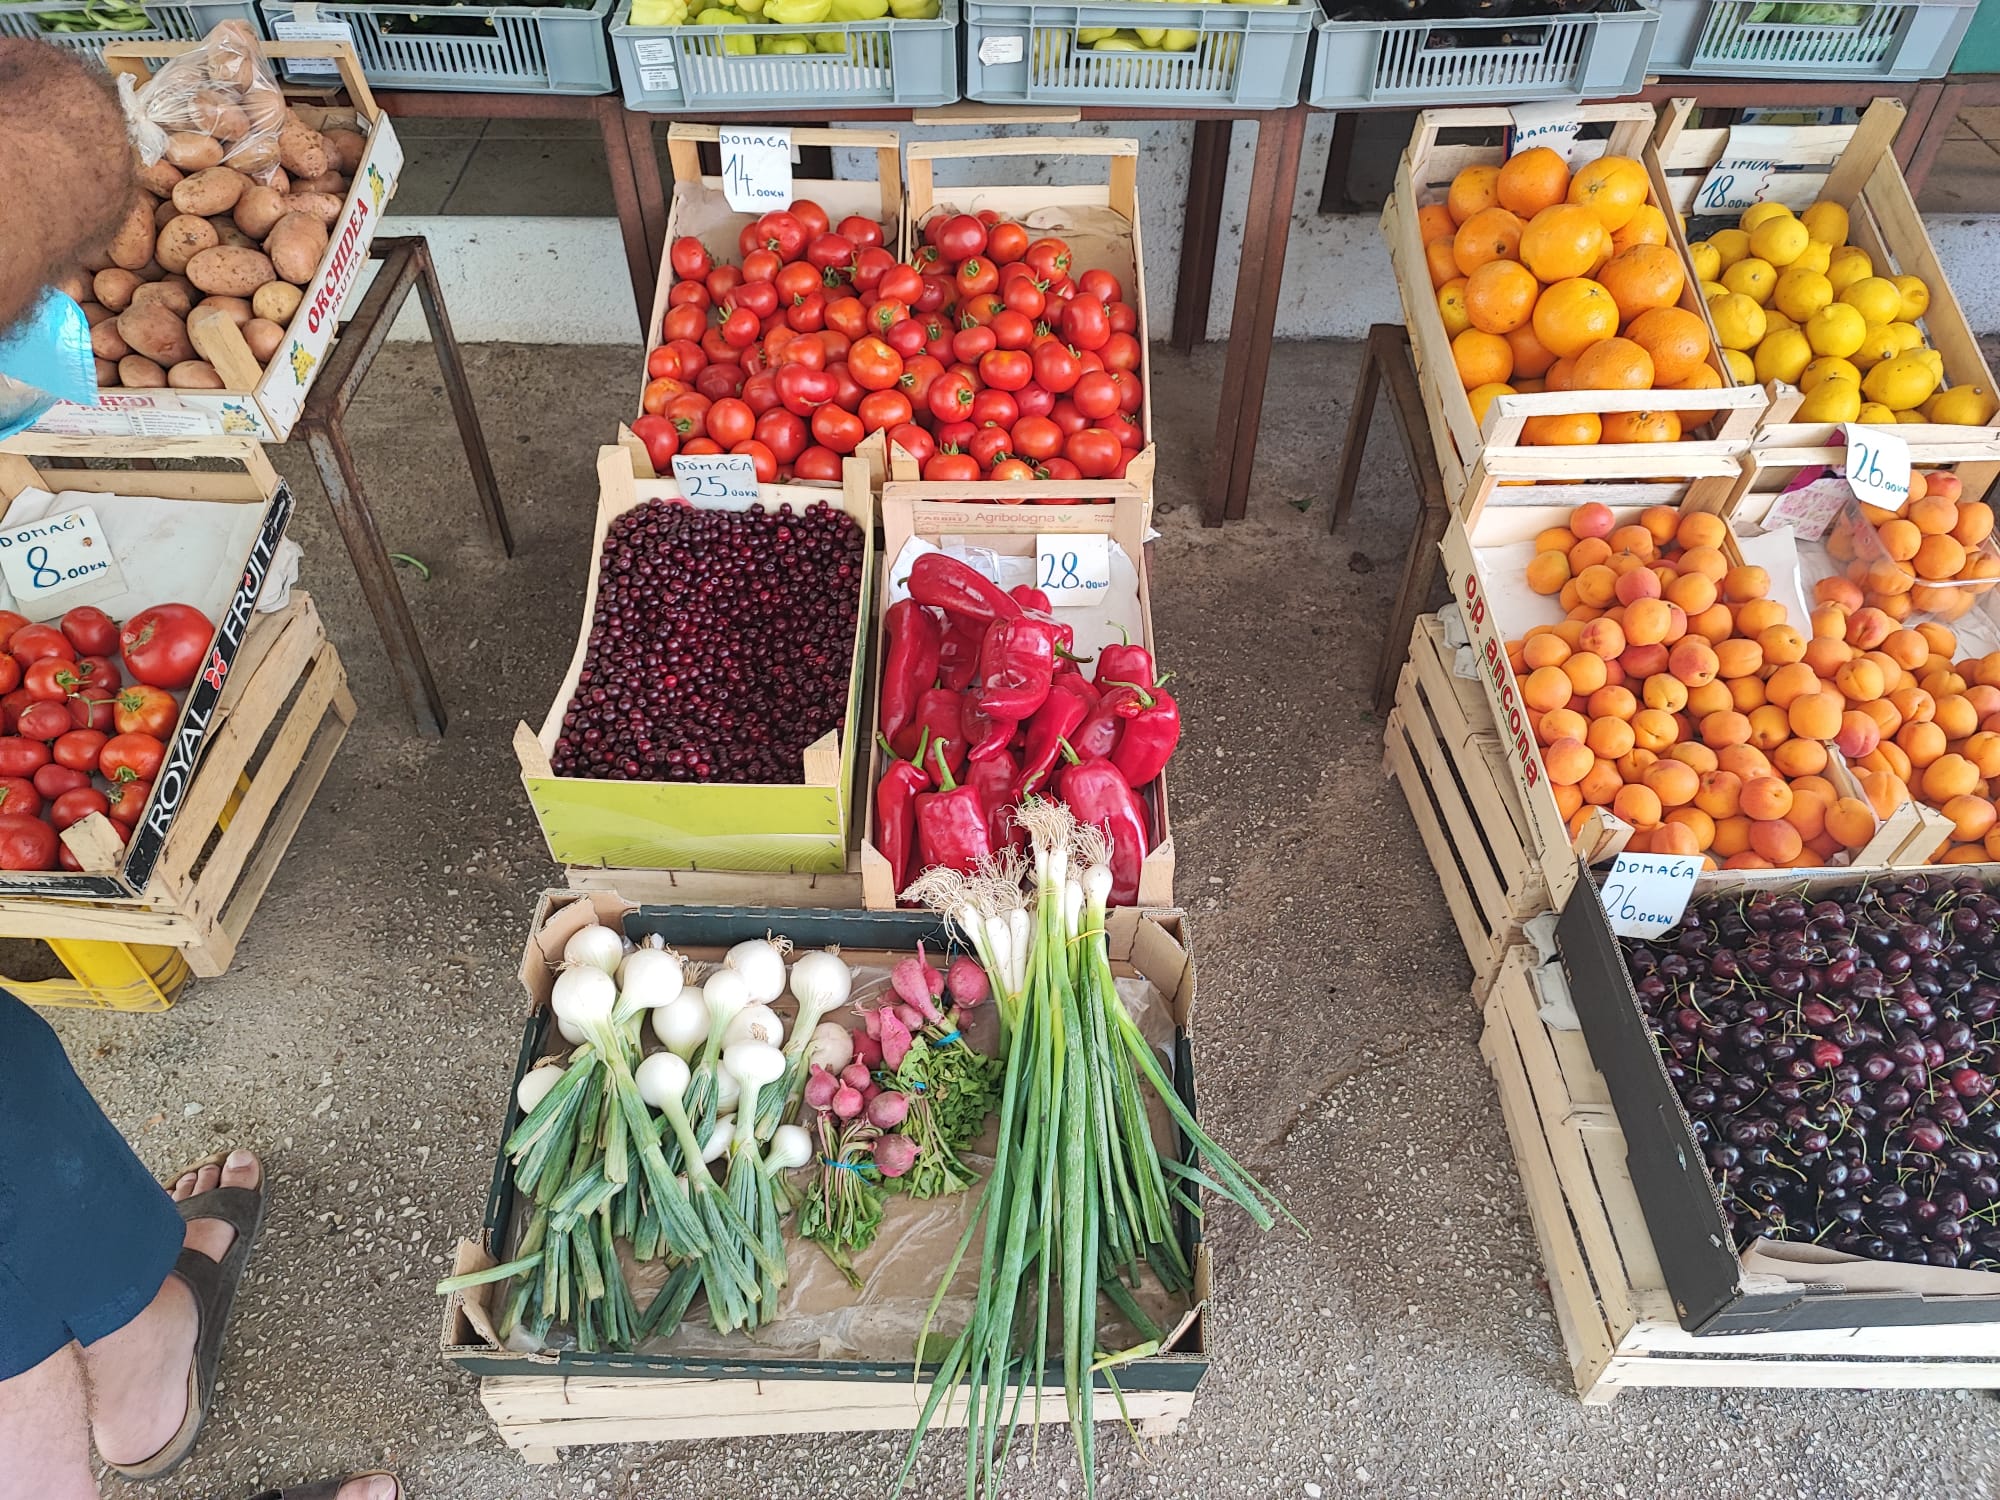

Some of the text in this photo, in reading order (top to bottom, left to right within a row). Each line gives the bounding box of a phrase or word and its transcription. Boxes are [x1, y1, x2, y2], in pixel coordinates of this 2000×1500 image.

[1715, 160, 1773, 171] LIMUN
[308, 198, 369, 334] ORCHIDEA
[331, 251, 361, 314] FRUTTA
[975, 512, 1055, 524] Agribologna
[149, 527, 274, 838] ROYAL FRUIT
[1484, 636, 1539, 789] ancona
